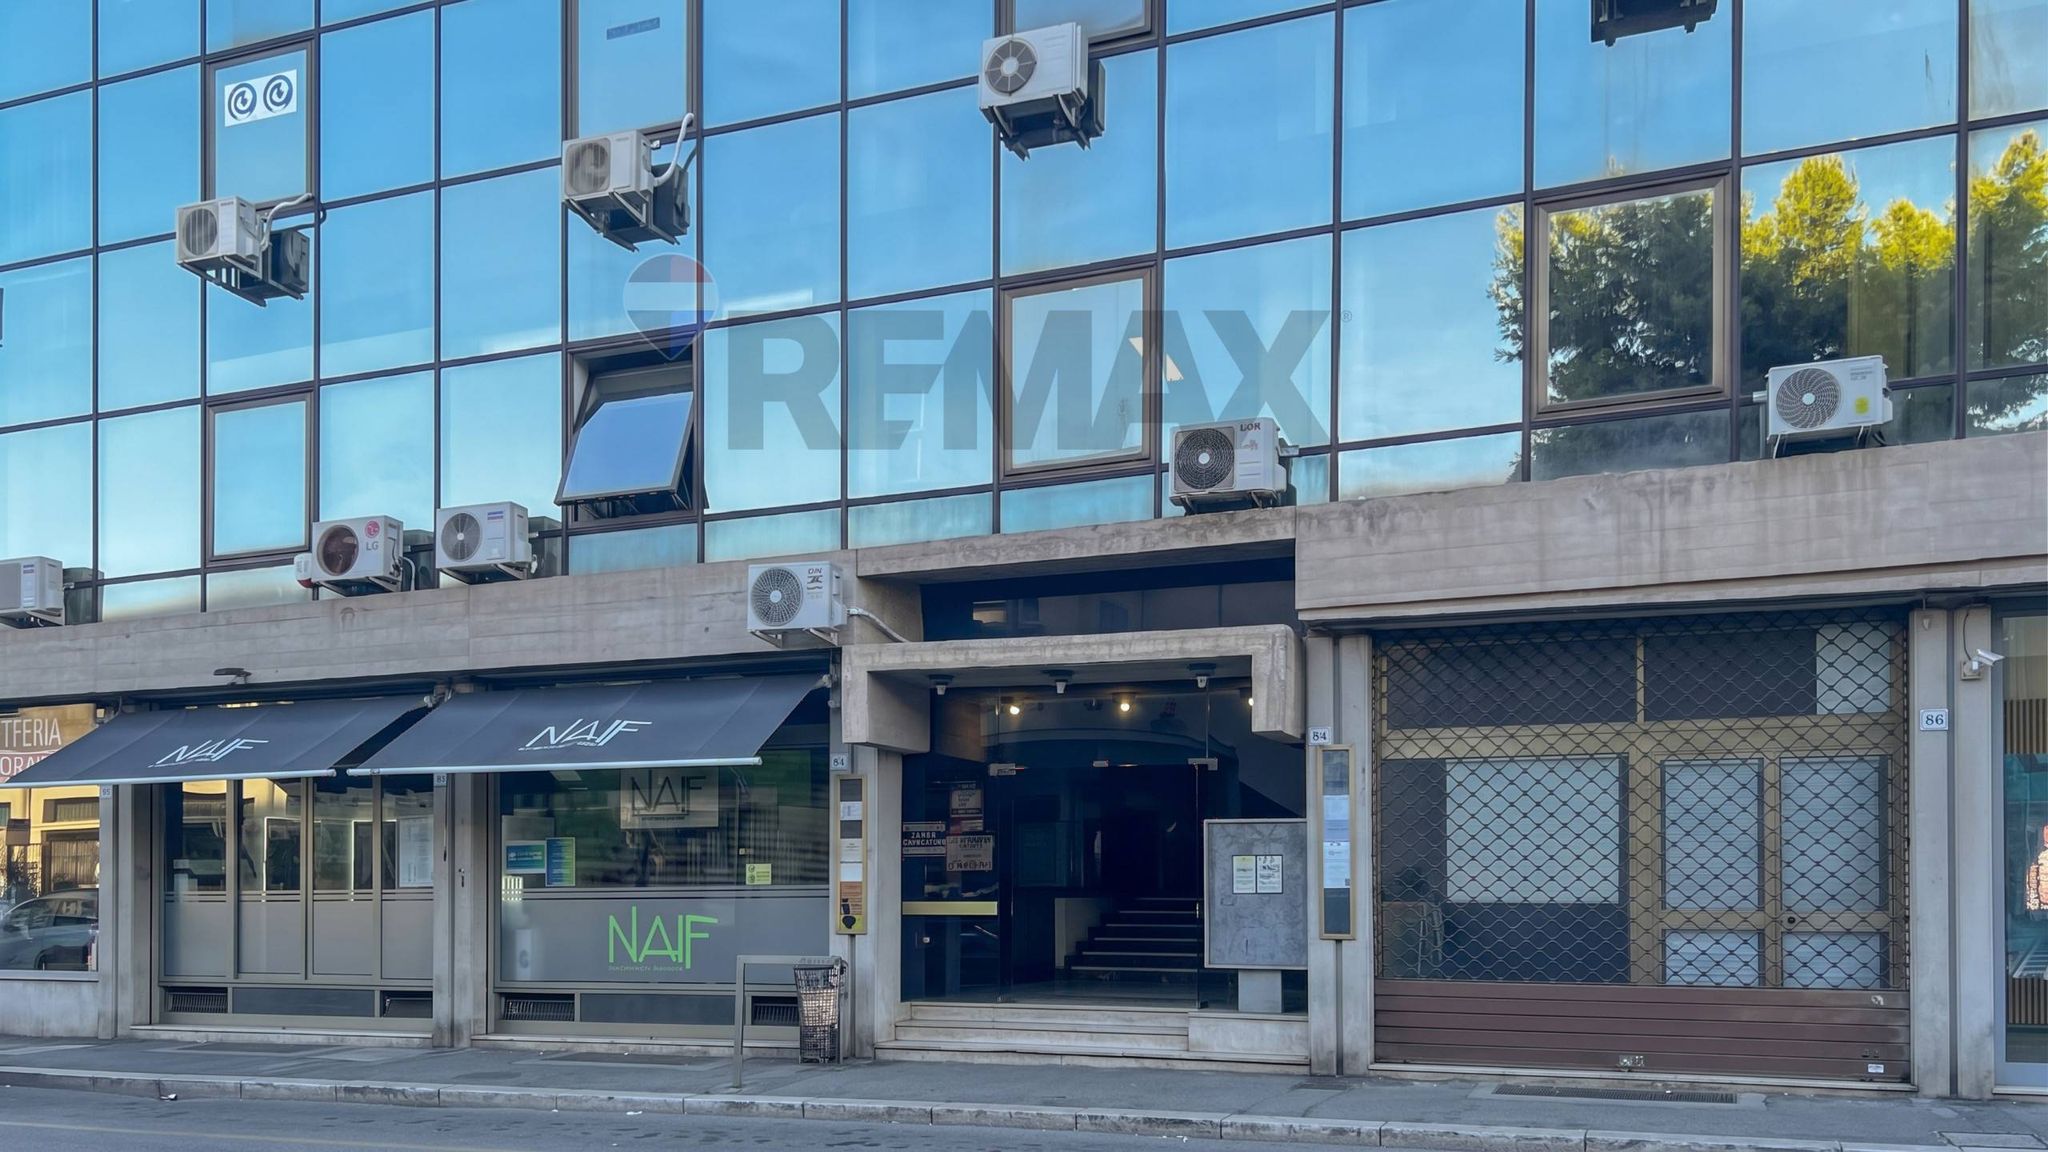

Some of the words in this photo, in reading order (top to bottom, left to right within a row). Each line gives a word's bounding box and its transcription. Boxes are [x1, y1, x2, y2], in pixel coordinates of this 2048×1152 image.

[366, 541, 379, 551] LG
[525, 718, 653, 747] NAIF
[1925, 714, 1944, 726] 86
[155, 738, 270, 763] NAIF
[630, 769, 706, 815] NAIF
[608, 905, 718, 969] NAIF
